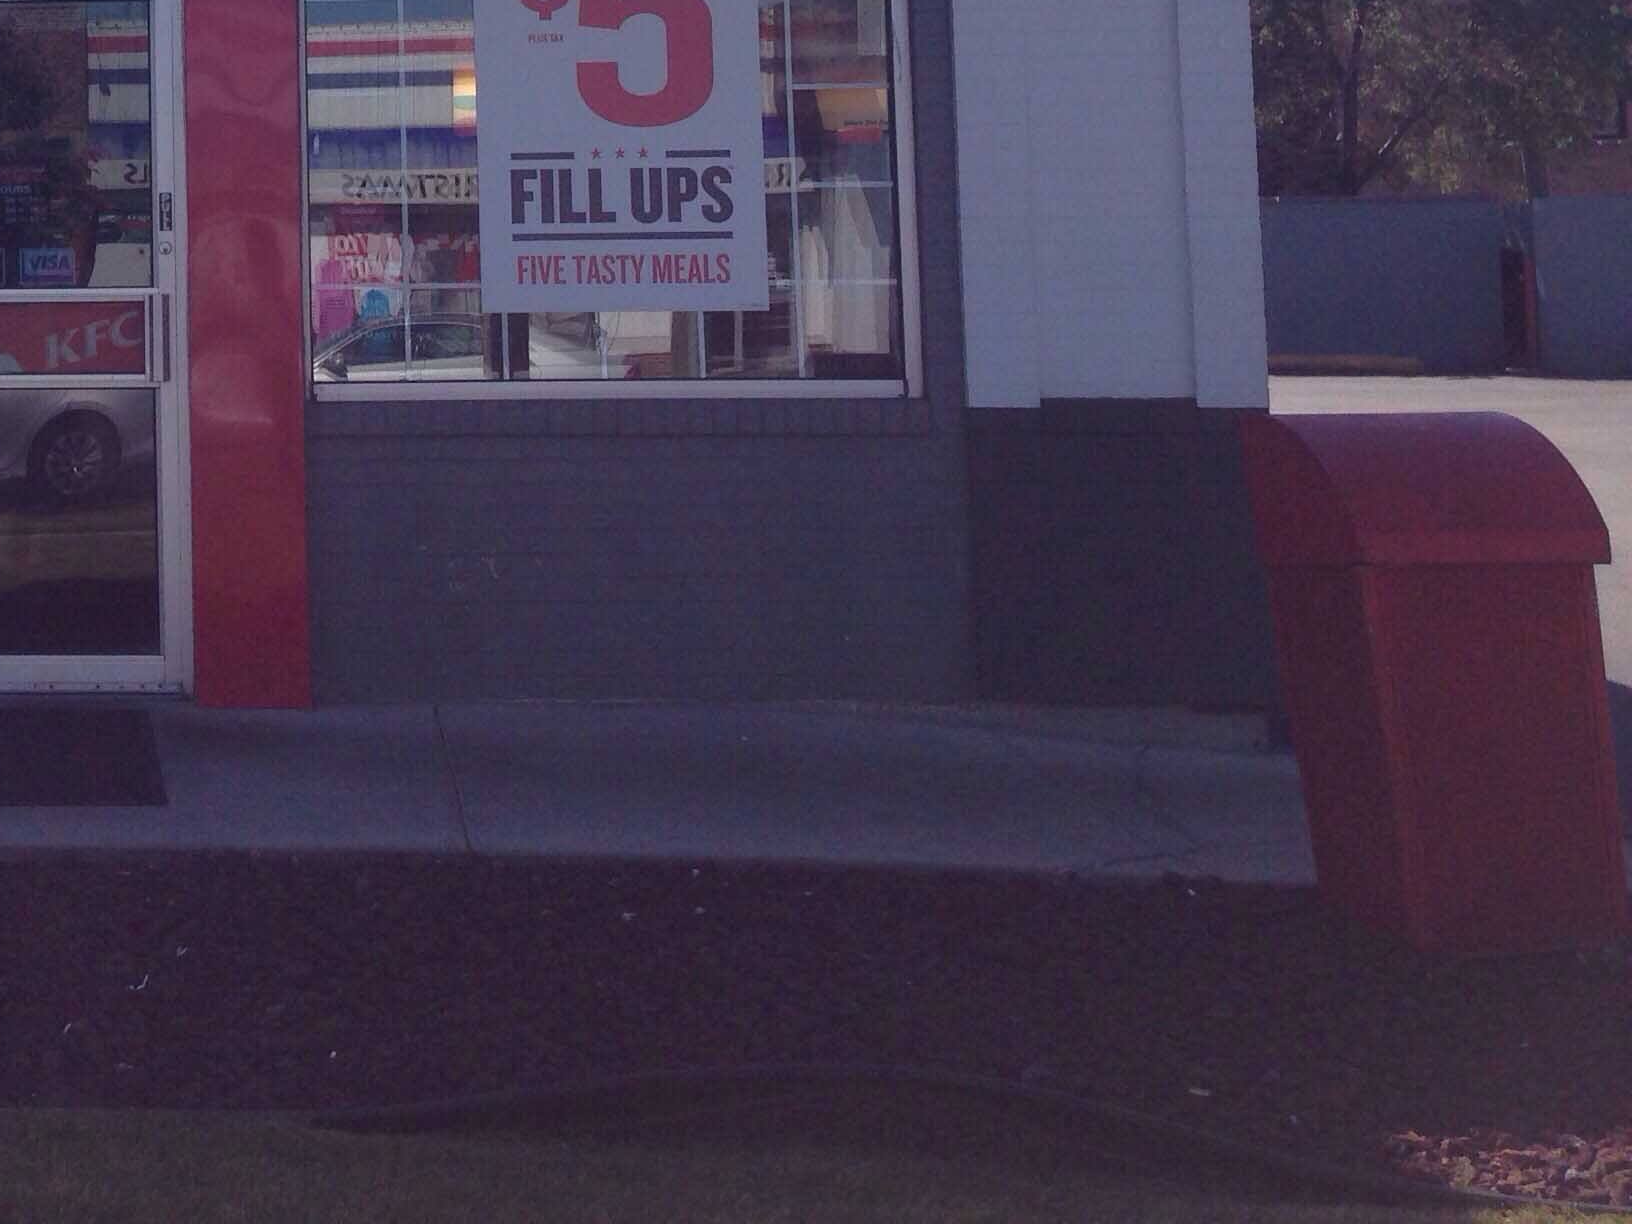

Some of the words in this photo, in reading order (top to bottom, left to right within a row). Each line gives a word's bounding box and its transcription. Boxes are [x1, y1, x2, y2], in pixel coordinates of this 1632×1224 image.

[510, 167, 617, 224] FILL
[630, 165, 734, 224] UPS
[28, 254, 70, 273] VISA
[517, 255, 567, 285] FIVE
[572, 254, 645, 285] TASTY
[652, 253, 731, 284] MEALS
[45, 311, 143, 369] KFC
